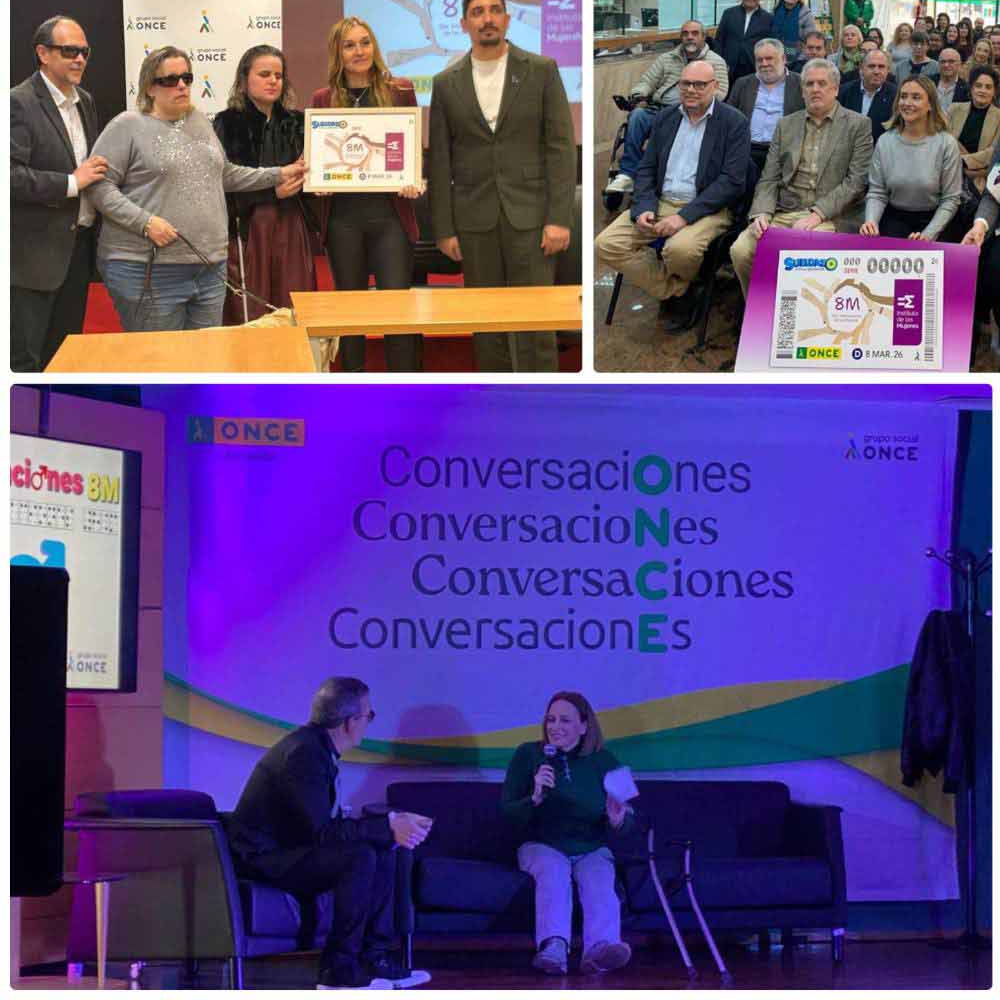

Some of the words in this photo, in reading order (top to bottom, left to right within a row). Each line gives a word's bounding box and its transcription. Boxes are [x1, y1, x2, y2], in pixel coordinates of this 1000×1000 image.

[136, 22, 167, 30] ONCE
[197, 54, 227, 62] ONCE
[843, 257, 861, 265] 000
[867, 257, 924, 274] 00000
[834, 297, 860, 311] 8M
[896, 323, 919, 331] Mujeres
[809, 349, 839, 358] ONCE
[866, 350, 871, 358] 8
[872, 350, 892, 358] MAR.
[893, 350, 903, 358] 26
[221, 421, 300, 442] ONCE
[864, 446, 919, 460] ONCE
[87, 472, 120, 504] 8M
[76, 661, 107, 674] ONCE
